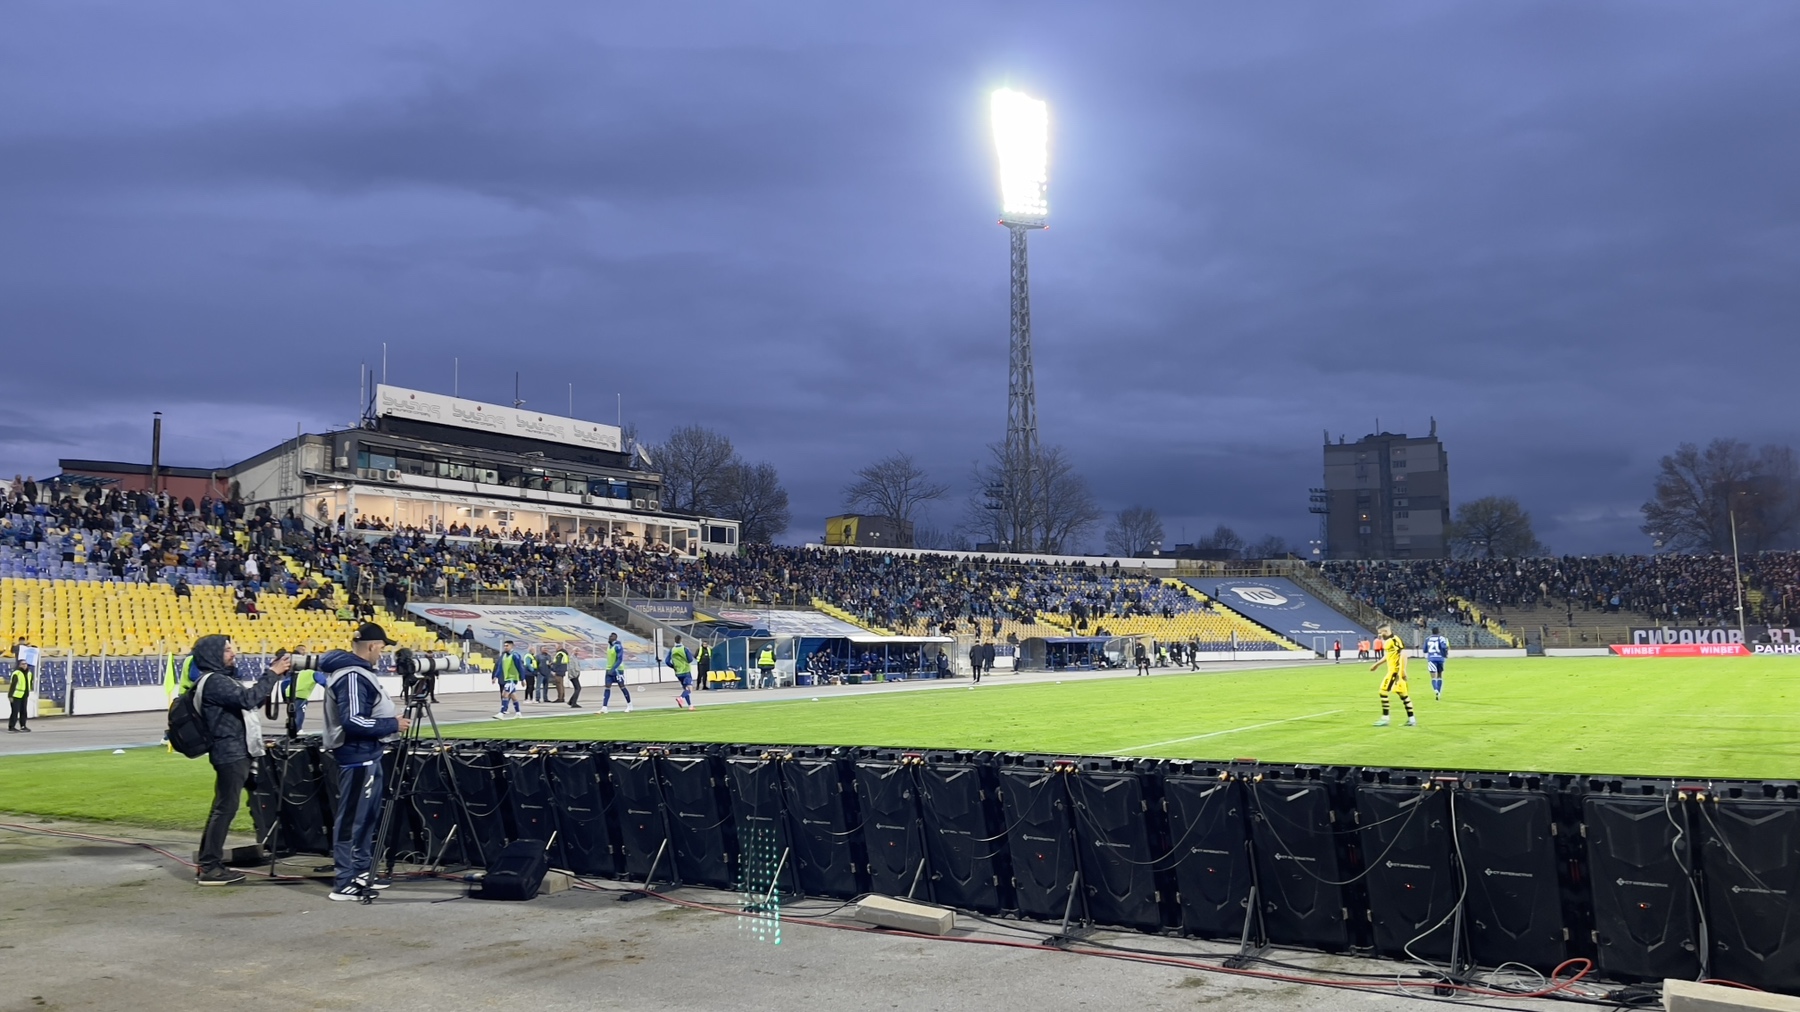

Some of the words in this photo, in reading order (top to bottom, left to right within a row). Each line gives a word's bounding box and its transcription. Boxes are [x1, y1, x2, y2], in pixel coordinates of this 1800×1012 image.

[1244, 591, 1277, 601] 110
[635, 604, 657, 613] ОТБОРА
[656, 605, 666, 613] НА
[665, 605, 689, 615] НАРОДА
[1427, 641, 1441, 653] 21
[1621, 646, 1661, 655] WINBET
[1700, 645, 1741, 655] WINBET
